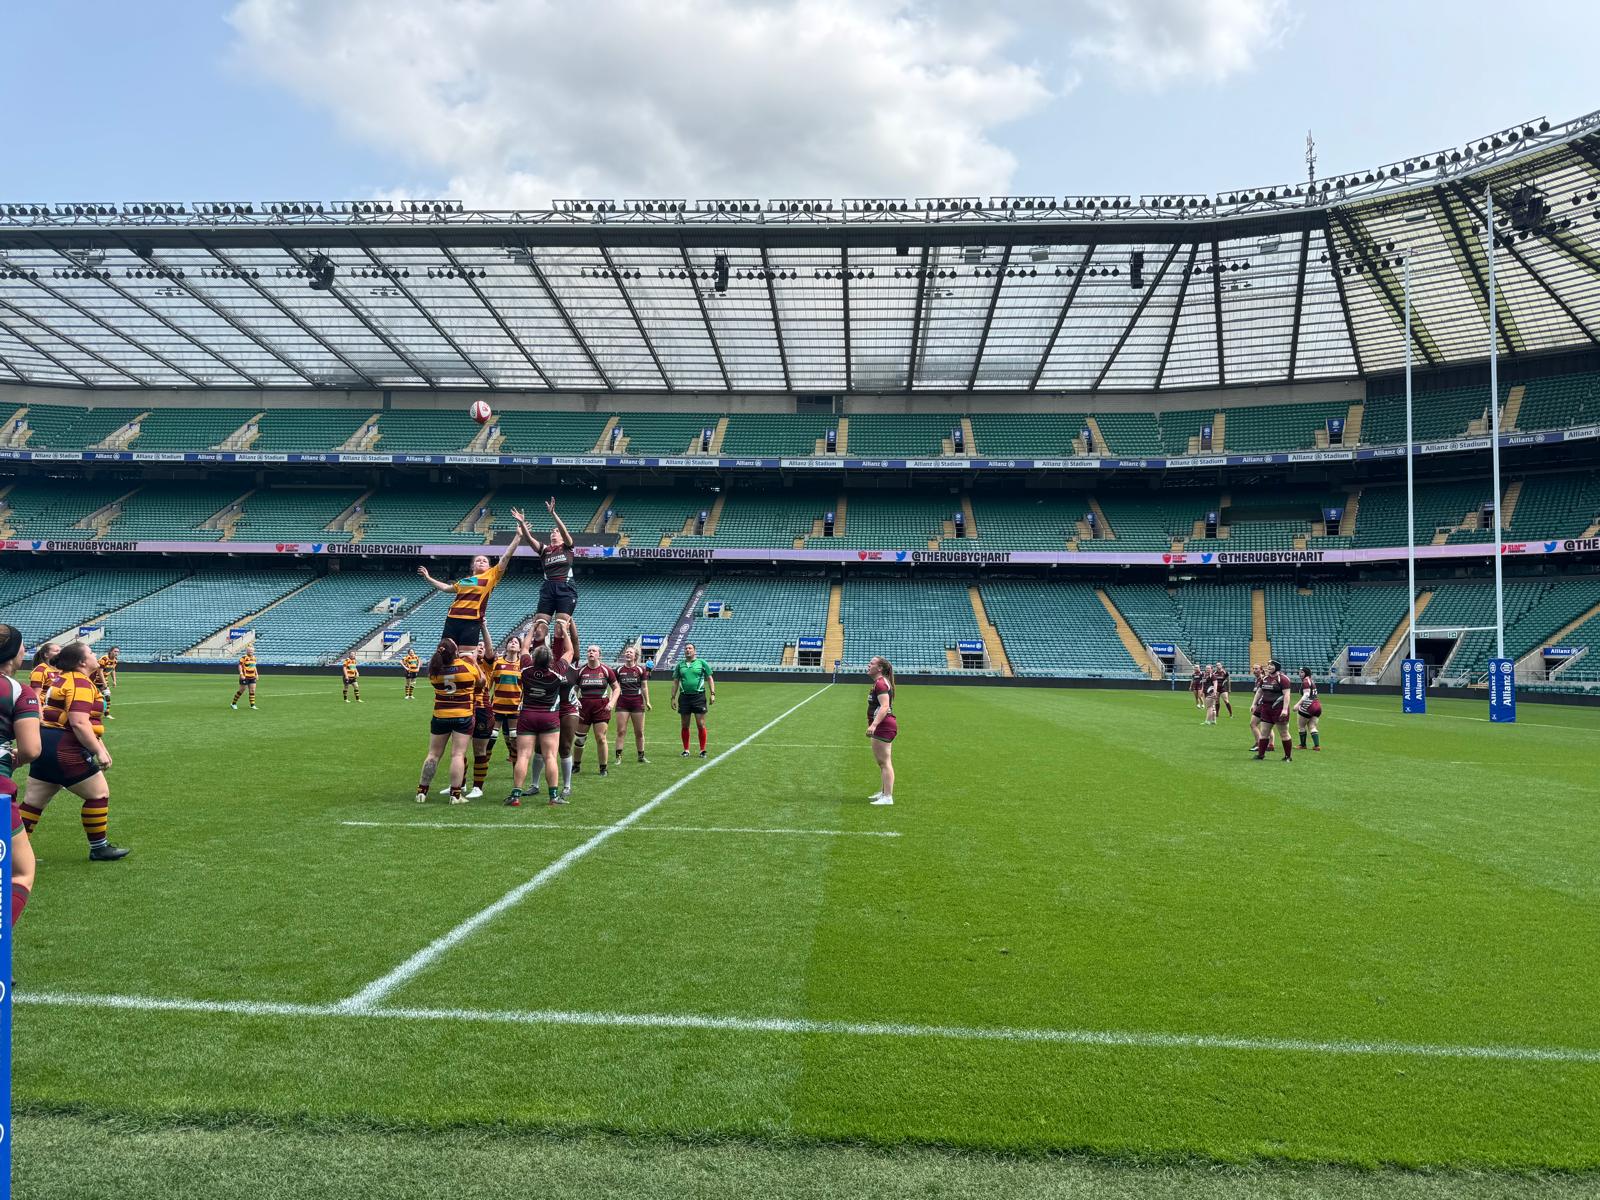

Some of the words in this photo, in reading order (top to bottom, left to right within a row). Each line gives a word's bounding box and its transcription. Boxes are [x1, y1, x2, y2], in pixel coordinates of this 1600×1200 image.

[1509, 434, 1534, 444] Allianz
[1568, 430, 1592, 438] Allianz
[1425, 444, 1448, 452] Allianz
[1460, 440, 1488, 448] Stadium
[46, 541, 138, 550] @THERUGBYCHARIT
[327, 544, 423, 554] @THERUGBYCHARIT
[618, 548, 714, 558] @THERUGBYCHARIT
[912, 552, 1011, 562] @THERUGBYCHARIT
[1218, 552, 1324, 563] @THERUGBYCHARIT
[444, 675, 457, 694] 5
[1503, 675, 1512, 706] Allianz
